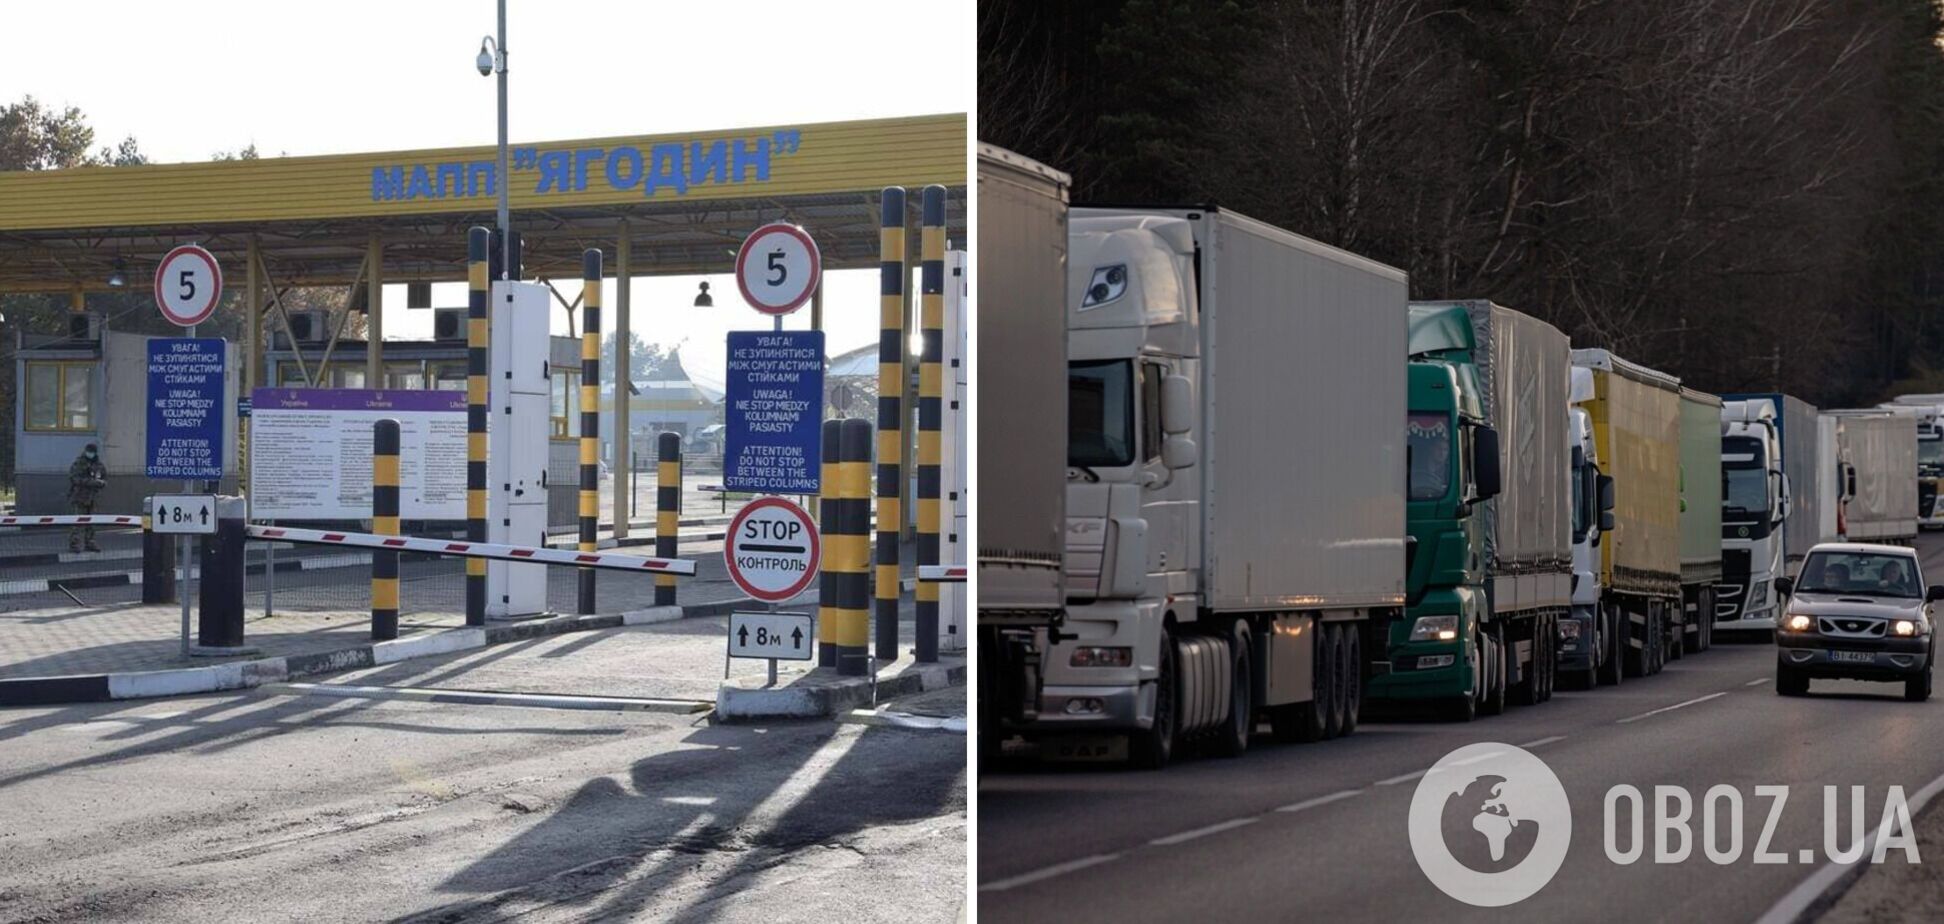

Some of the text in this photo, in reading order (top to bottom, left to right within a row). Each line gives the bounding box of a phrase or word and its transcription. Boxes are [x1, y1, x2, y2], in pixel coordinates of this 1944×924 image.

[371, 160, 496, 201] МАПП
[767, 252, 788, 287] 5
[180, 271, 195, 301] 5
[757, 337, 793, 347] УВАГА!
[171, 343, 200, 352] УВАГА!
[154, 354, 218, 363] НЕ ЗУПИНЯТИСЯ
[734, 349, 815, 359] НЕ ЗУПИНЯТИСЯ
[148, 364, 223, 373] МІЖ СМУГАСТИМИ
[728, 360, 821, 371] МІЖ СМУГАСТИМИ
[164, 374, 206, 384] СТІЙКАМИ
[747, 370, 800, 382] СТІЙКАМИ
[154, 400, 168, 408] NIE
[168, 400, 187, 408] STOP
[735, 400, 750, 410] NIE
[750, 400, 775, 410] STOP
[162, 409, 207, 418] KOLUMNAMI
[744, 411, 799, 421] KOLUMNAMI
[166, 419, 202, 427] PASIASTY
[749, 422, 794, 432] PASIASTY
[161, 439, 209, 448] ATTENTION!
[158, 448, 211, 457] DO NOT STOP
[743, 446, 802, 456] ATTENTION!
[156, 457, 212, 467] BETWEEN THE
[740, 456, 805, 467] DO NOT STOP
[147, 466, 221, 476] STRIPED COLUMNS
[737, 467, 807, 478] BETWEEN THE
[727, 477, 818, 489] STRIPED COLUMNS
[745, 519, 801, 541] STOP
[738, 556, 807, 572] КОНТРОЛЬ
